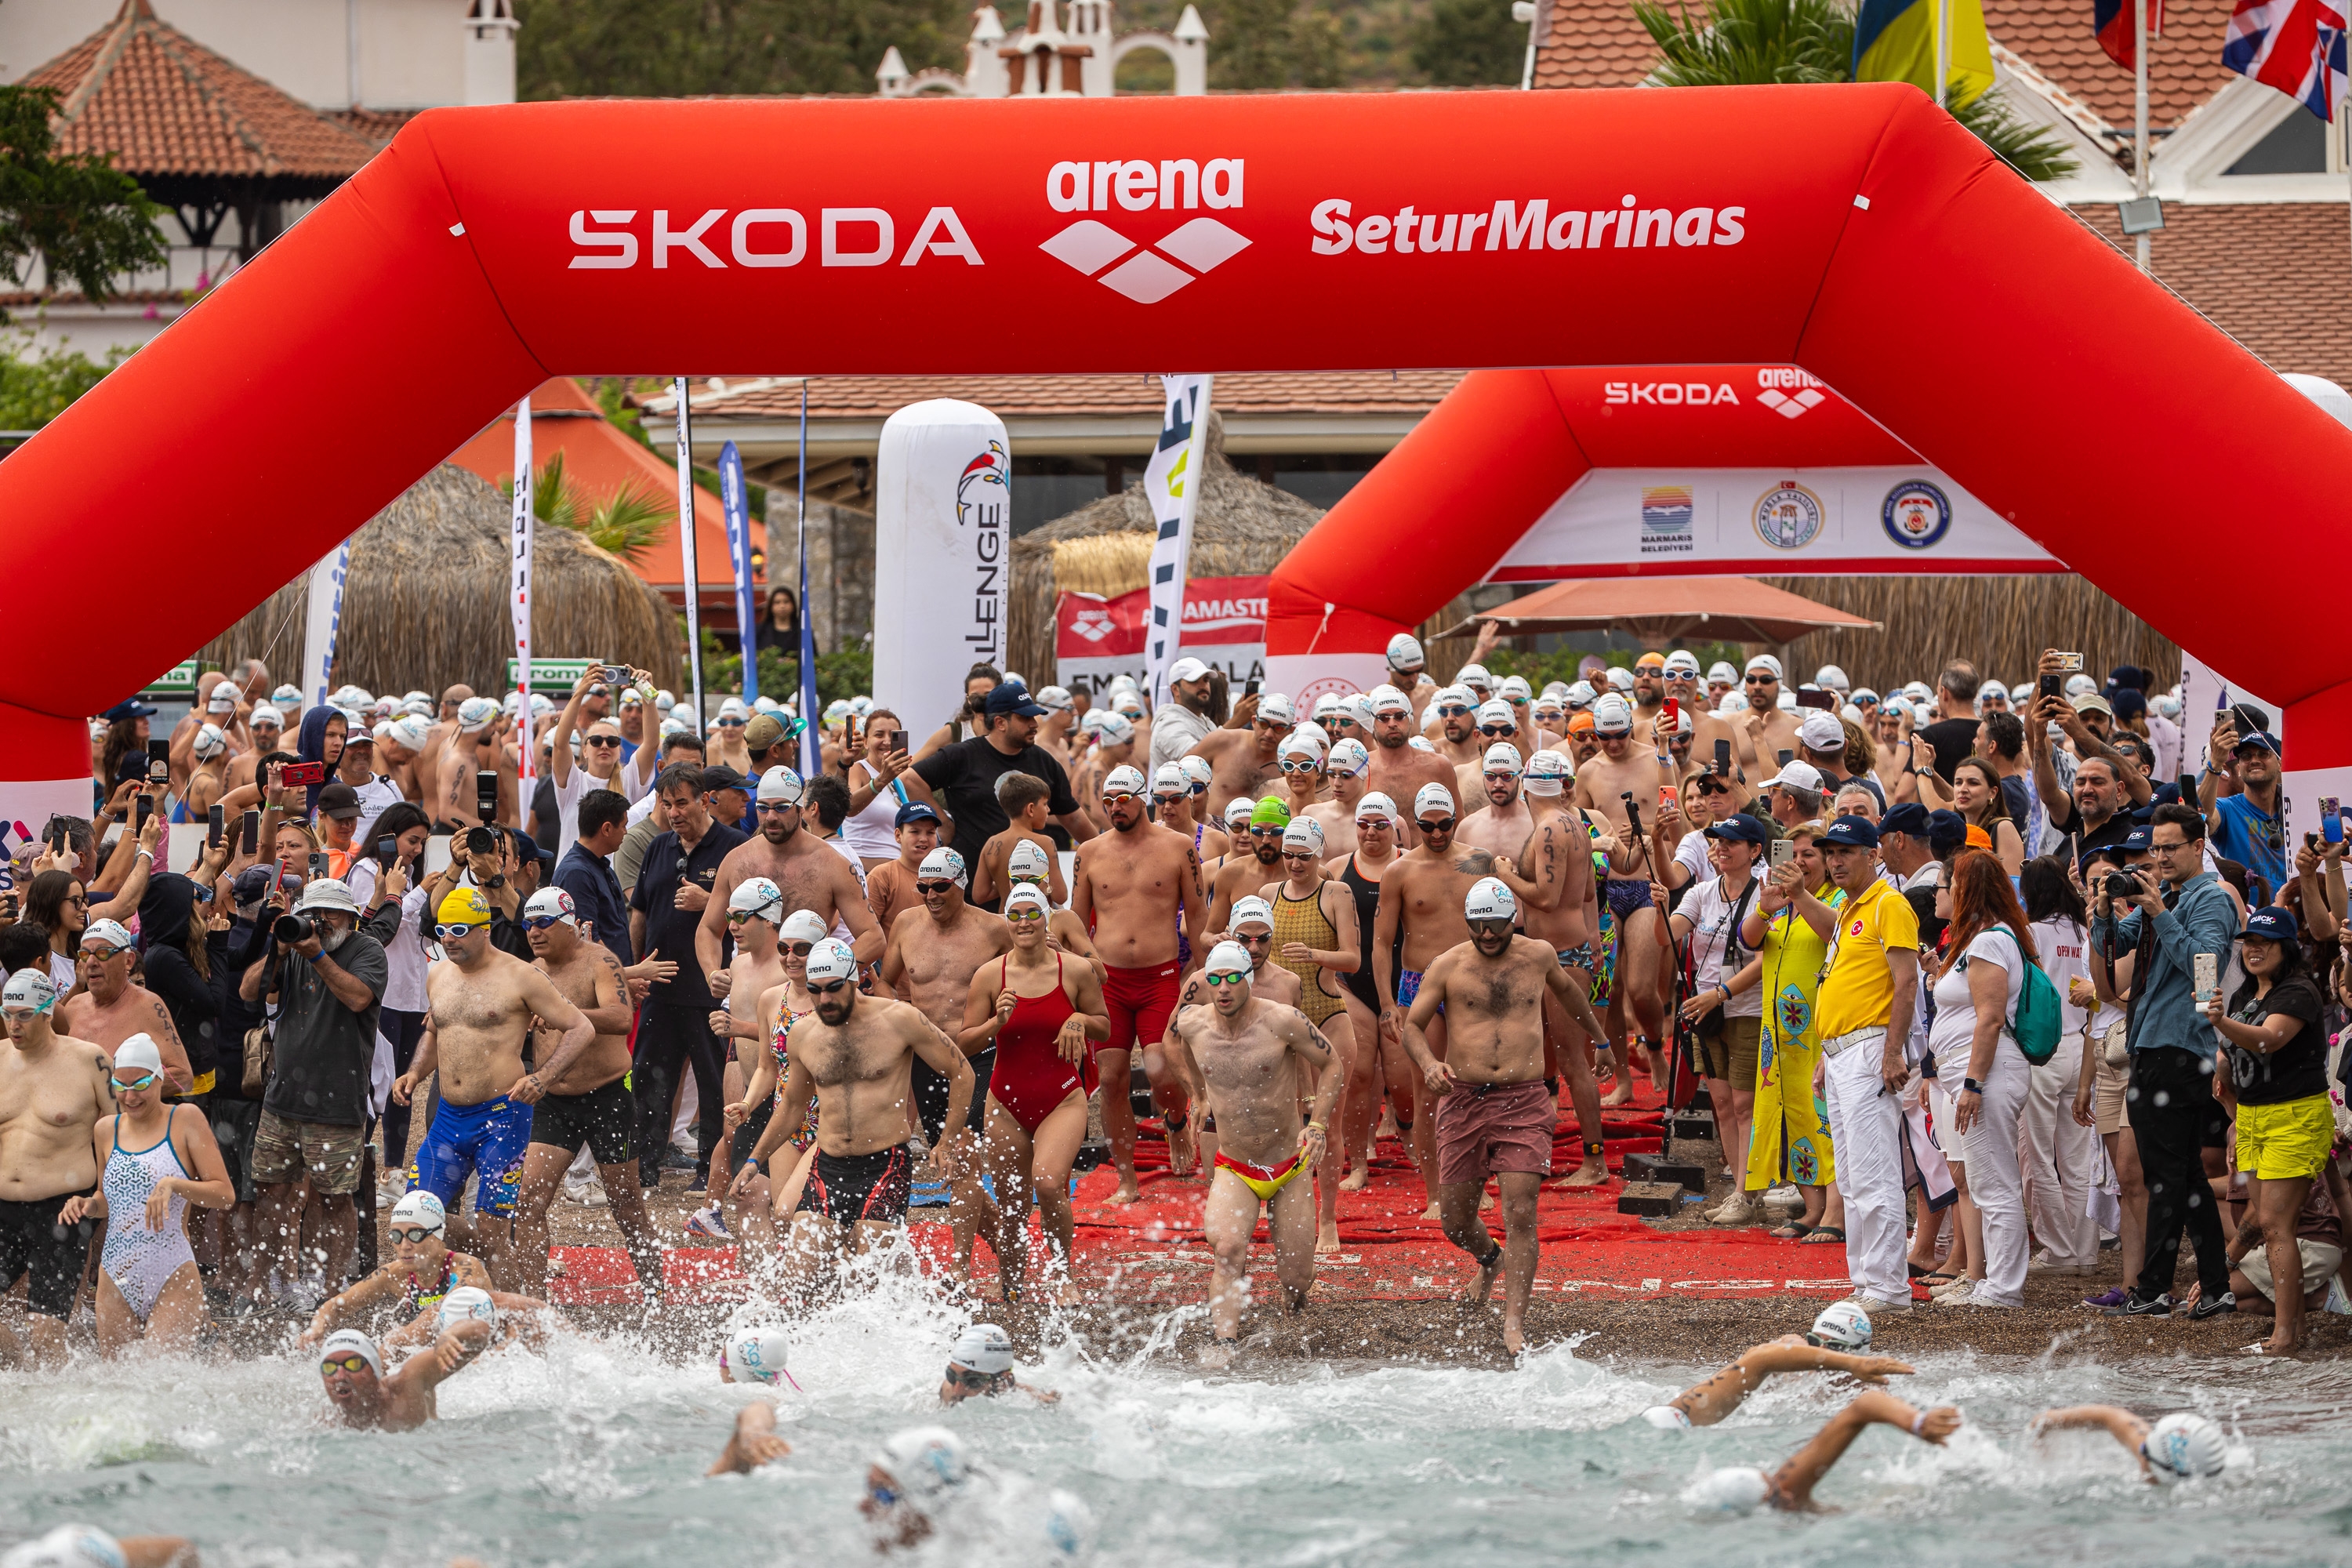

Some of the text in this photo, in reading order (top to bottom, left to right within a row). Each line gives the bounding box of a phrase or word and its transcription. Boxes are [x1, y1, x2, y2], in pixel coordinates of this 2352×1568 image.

[1046, 158, 1246, 212] arena
[1310, 194, 1746, 255] SeturMarinas
[1265, 709, 1287, 718] arena
[1828, 823, 1849, 833] QUICK
[1543, 826, 1555, 884] 295
[1185, 848, 1203, 897] 876
[524, 905, 545, 913] arena
[1469, 906, 1493, 915] arena
[2249, 915, 2273, 924] QUICK
[2056, 945, 2071, 957] OPEN
[808, 964, 832, 975] arena
[3, 993, 25, 1001] arena
[1061, 1075, 1077, 1090] arena
[1821, 1319, 1847, 1334] arena
